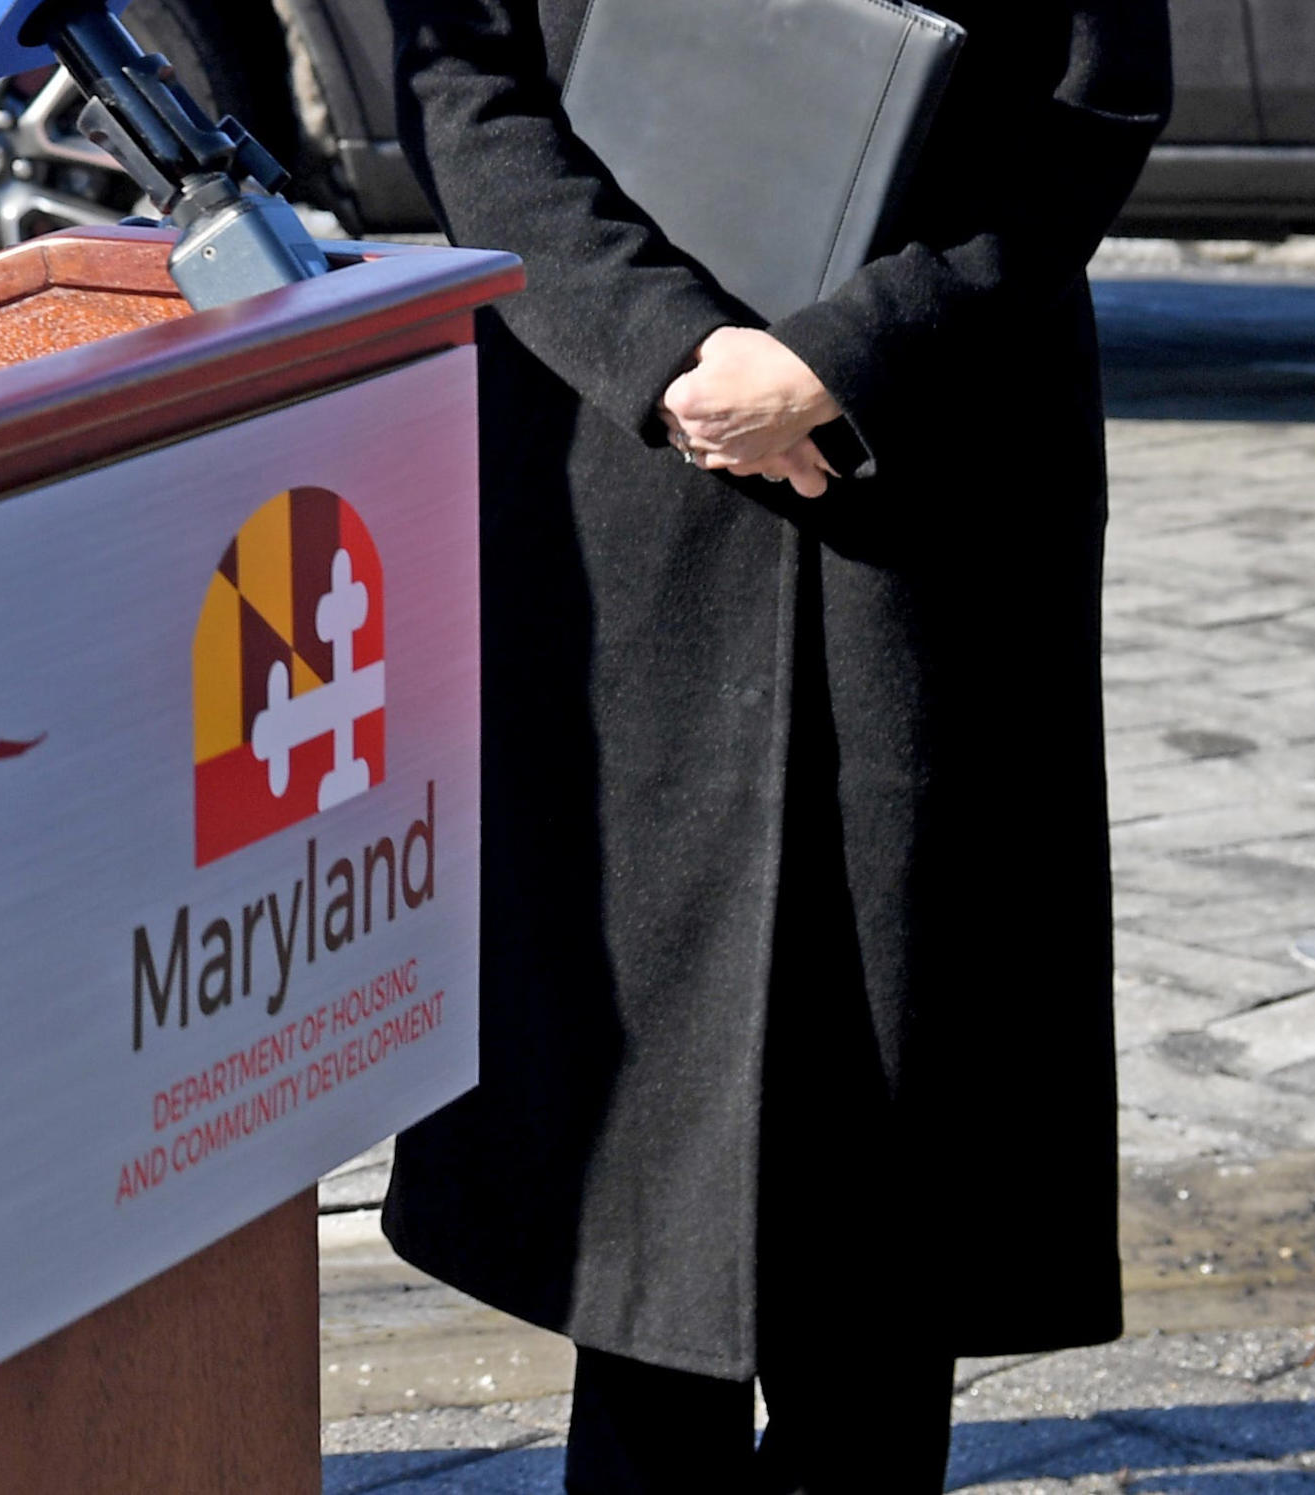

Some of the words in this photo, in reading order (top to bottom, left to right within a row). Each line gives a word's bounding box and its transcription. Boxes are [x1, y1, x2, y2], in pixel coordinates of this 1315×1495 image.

[132, 779, 435, 1053] Maryland
[115, 1145, 168, 1206] AND
[172, 1070, 304, 1173] COMMUNITY
[306, 989, 445, 1101] DEVELOPMENT
[153, 1021, 297, 1133] DEPARTMENT
[300, 1006, 327, 1052] OF
[331, 957, 418, 1036] HOUSING
